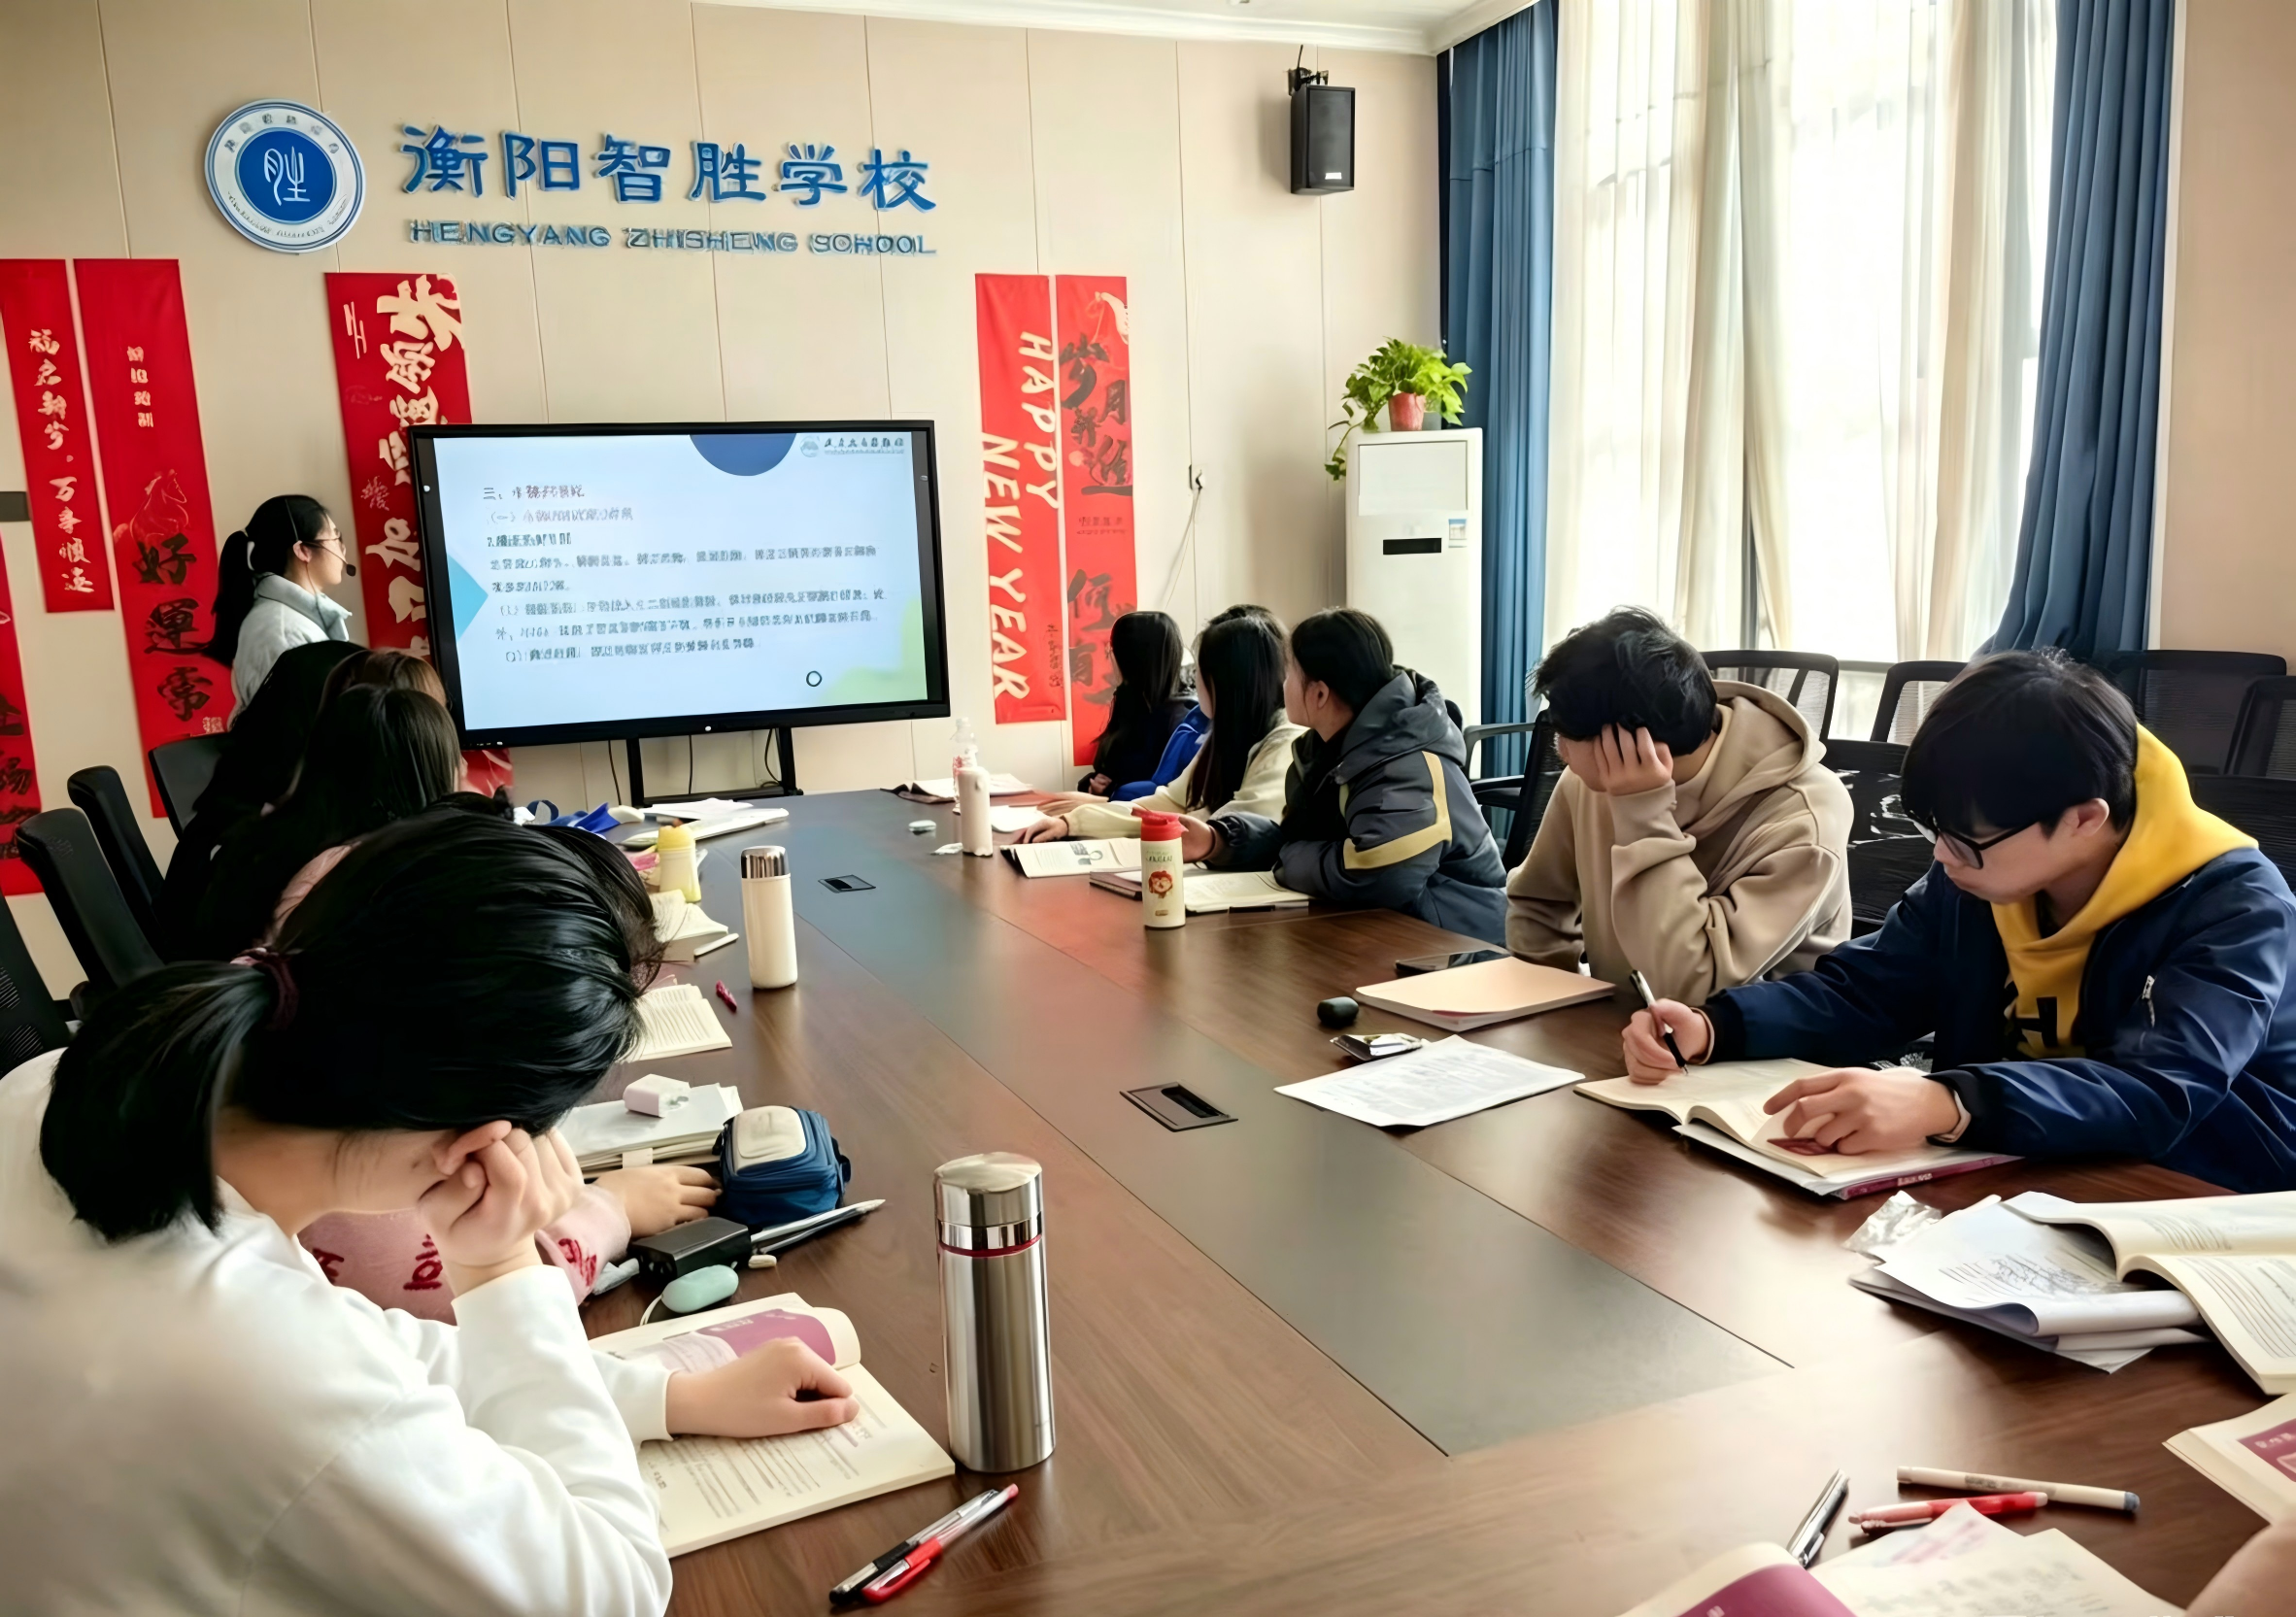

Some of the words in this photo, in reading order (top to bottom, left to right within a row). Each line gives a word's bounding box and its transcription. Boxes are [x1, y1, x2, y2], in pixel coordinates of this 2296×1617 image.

[398, 122, 938, 212] 衡阳智胜学校
[409, 219, 611, 248] HENGYANG
[623, 227, 799, 253] ZHISHENG
[808, 233, 936, 255] SCHOOL
[1018, 330, 1060, 510] HAPPY
[982, 431, 1025, 555] NEW
[990, 567, 1030, 700] YEAR
